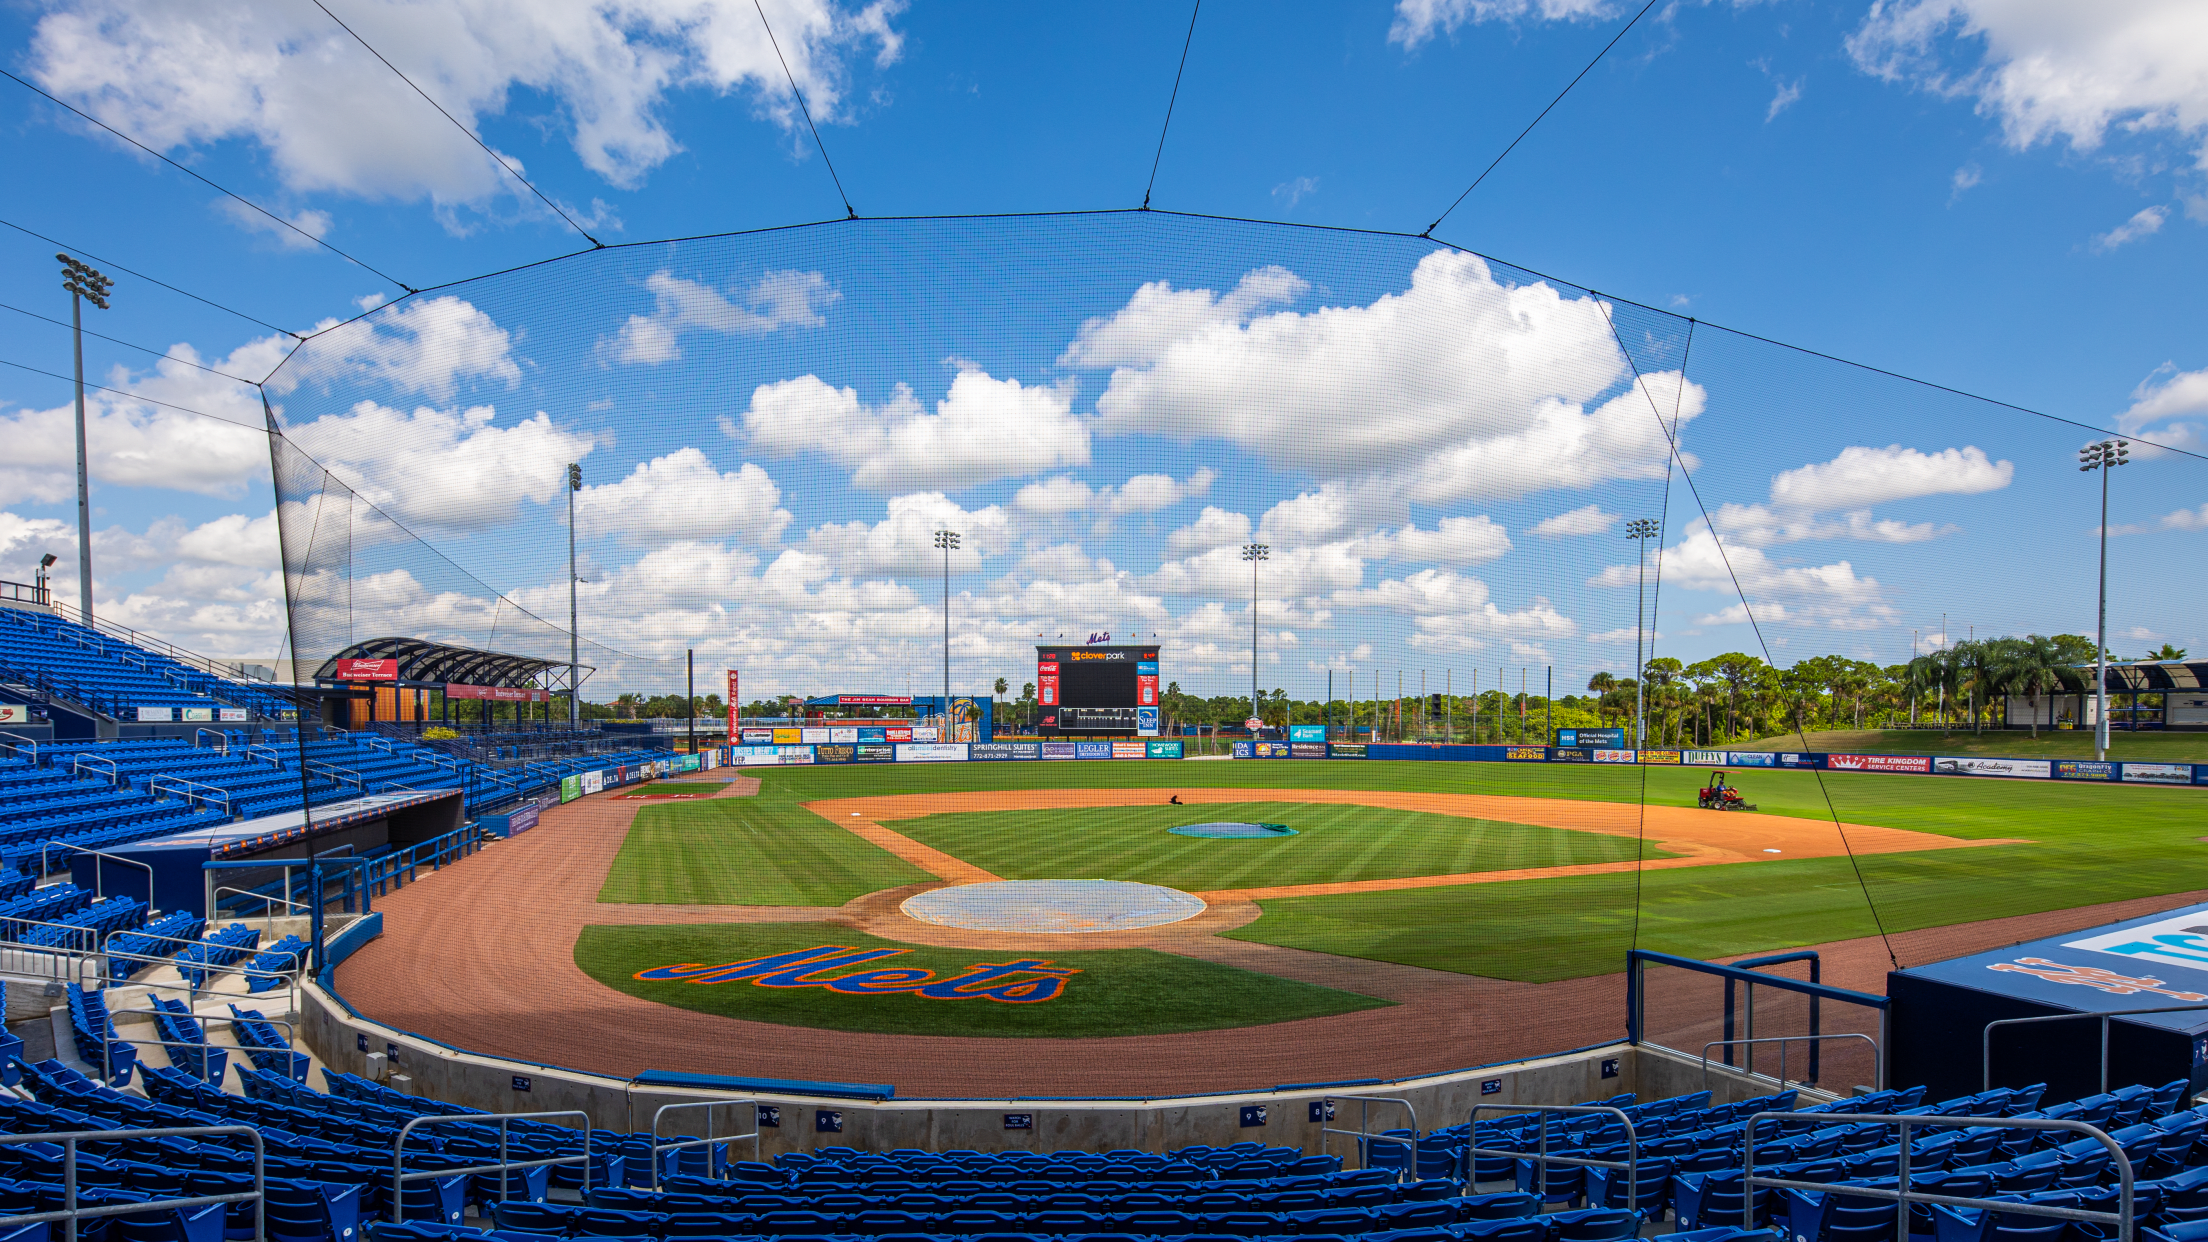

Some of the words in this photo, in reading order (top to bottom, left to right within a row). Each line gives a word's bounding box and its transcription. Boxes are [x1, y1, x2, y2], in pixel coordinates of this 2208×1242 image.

[1086, 631, 1110, 645] Mets
[1139, 716, 1156, 725] SLEEP
[1976, 762, 2013, 772] Academy
[607, 774, 618, 784] DELTA
[629, 770, 639, 779] DELTA
[632, 945, 1084, 1002] Mets
